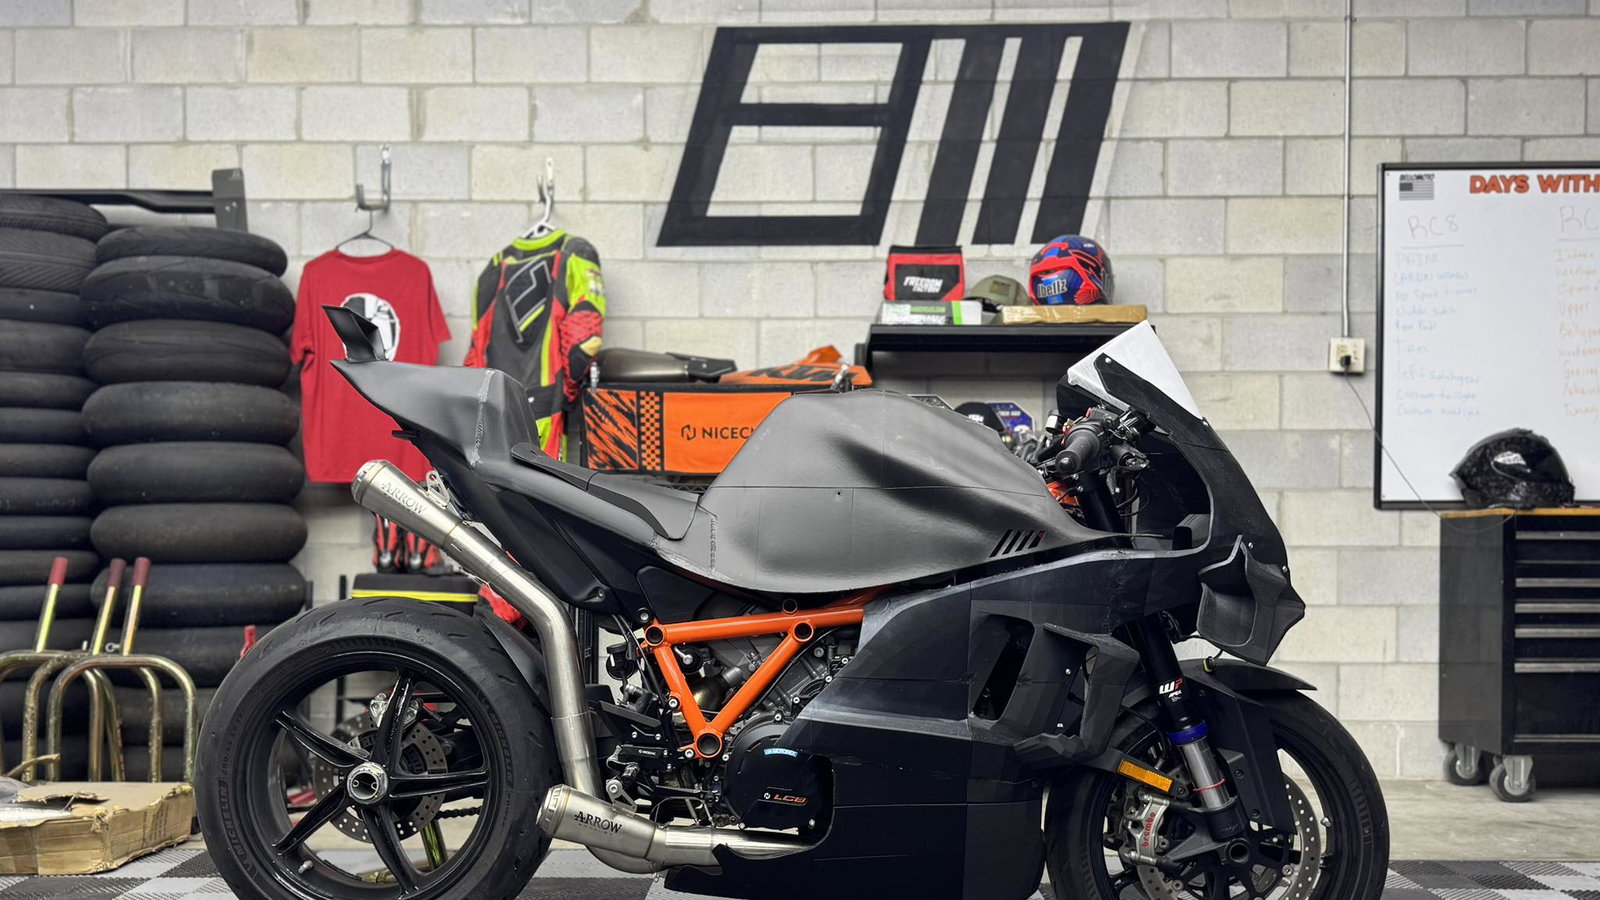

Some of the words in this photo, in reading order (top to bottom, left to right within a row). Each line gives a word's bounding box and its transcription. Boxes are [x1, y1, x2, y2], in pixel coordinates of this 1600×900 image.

[1469, 174, 1530, 194] DAYS
[1537, 173, 1600, 193] WITH
[702, 426, 754, 439] NICEC
[382, 482, 427, 514] ARROW
[574, 810, 622, 833] ARROW
[1141, 812, 1156, 848] brembo
